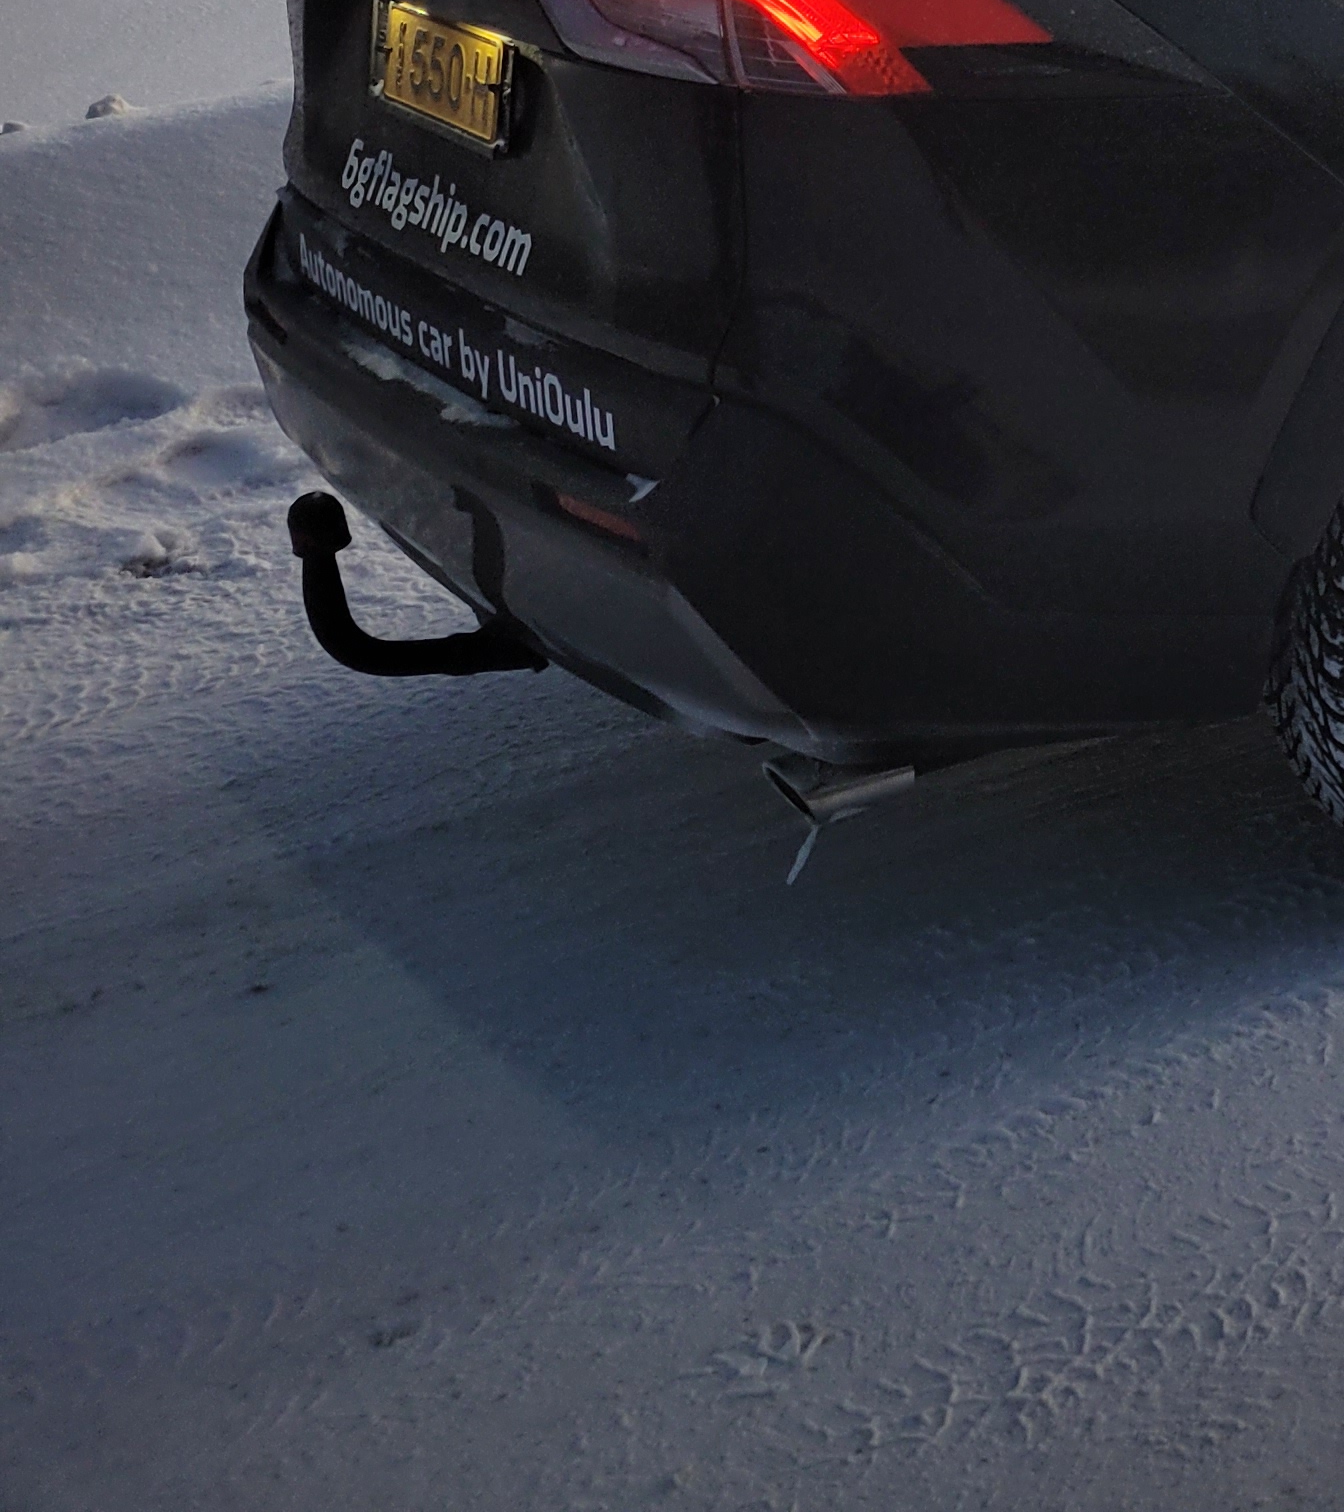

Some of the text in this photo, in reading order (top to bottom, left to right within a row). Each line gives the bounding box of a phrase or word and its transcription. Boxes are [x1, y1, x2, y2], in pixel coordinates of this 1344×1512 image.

[341, 138, 532, 276] 6gflagship.com
[299, 232, 617, 451] Autonomous car by UniOulu
